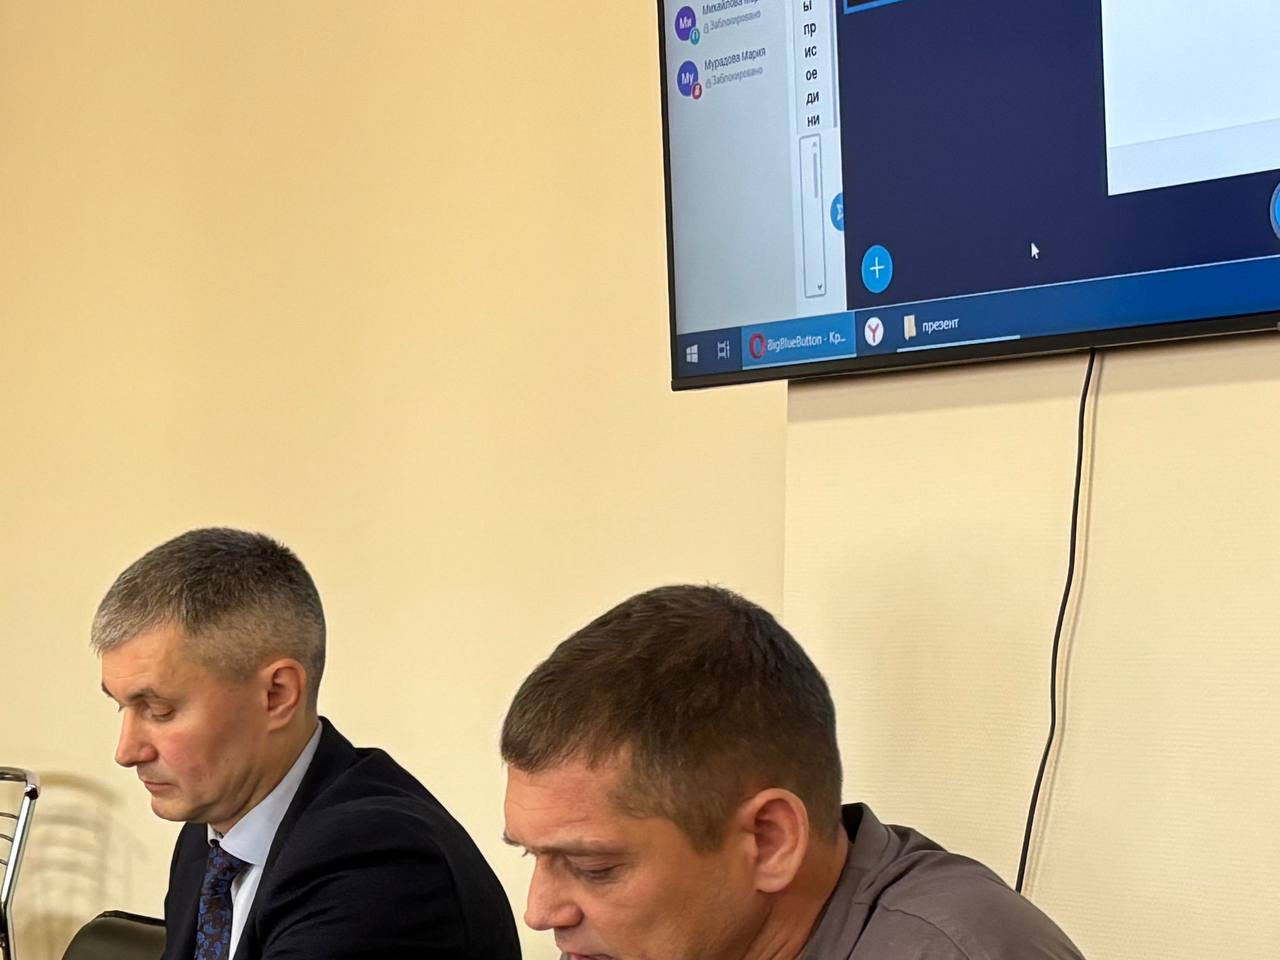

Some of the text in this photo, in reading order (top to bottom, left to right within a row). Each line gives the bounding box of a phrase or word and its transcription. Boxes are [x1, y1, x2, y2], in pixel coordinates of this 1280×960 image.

[803, 23, 817, 37] пр
[804, 46, 817, 58] ис
[806, 69, 818, 81] ое
[806, 91, 820, 106] ди
[807, 115, 820, 127] ни
[923, 319, 959, 334] презент
